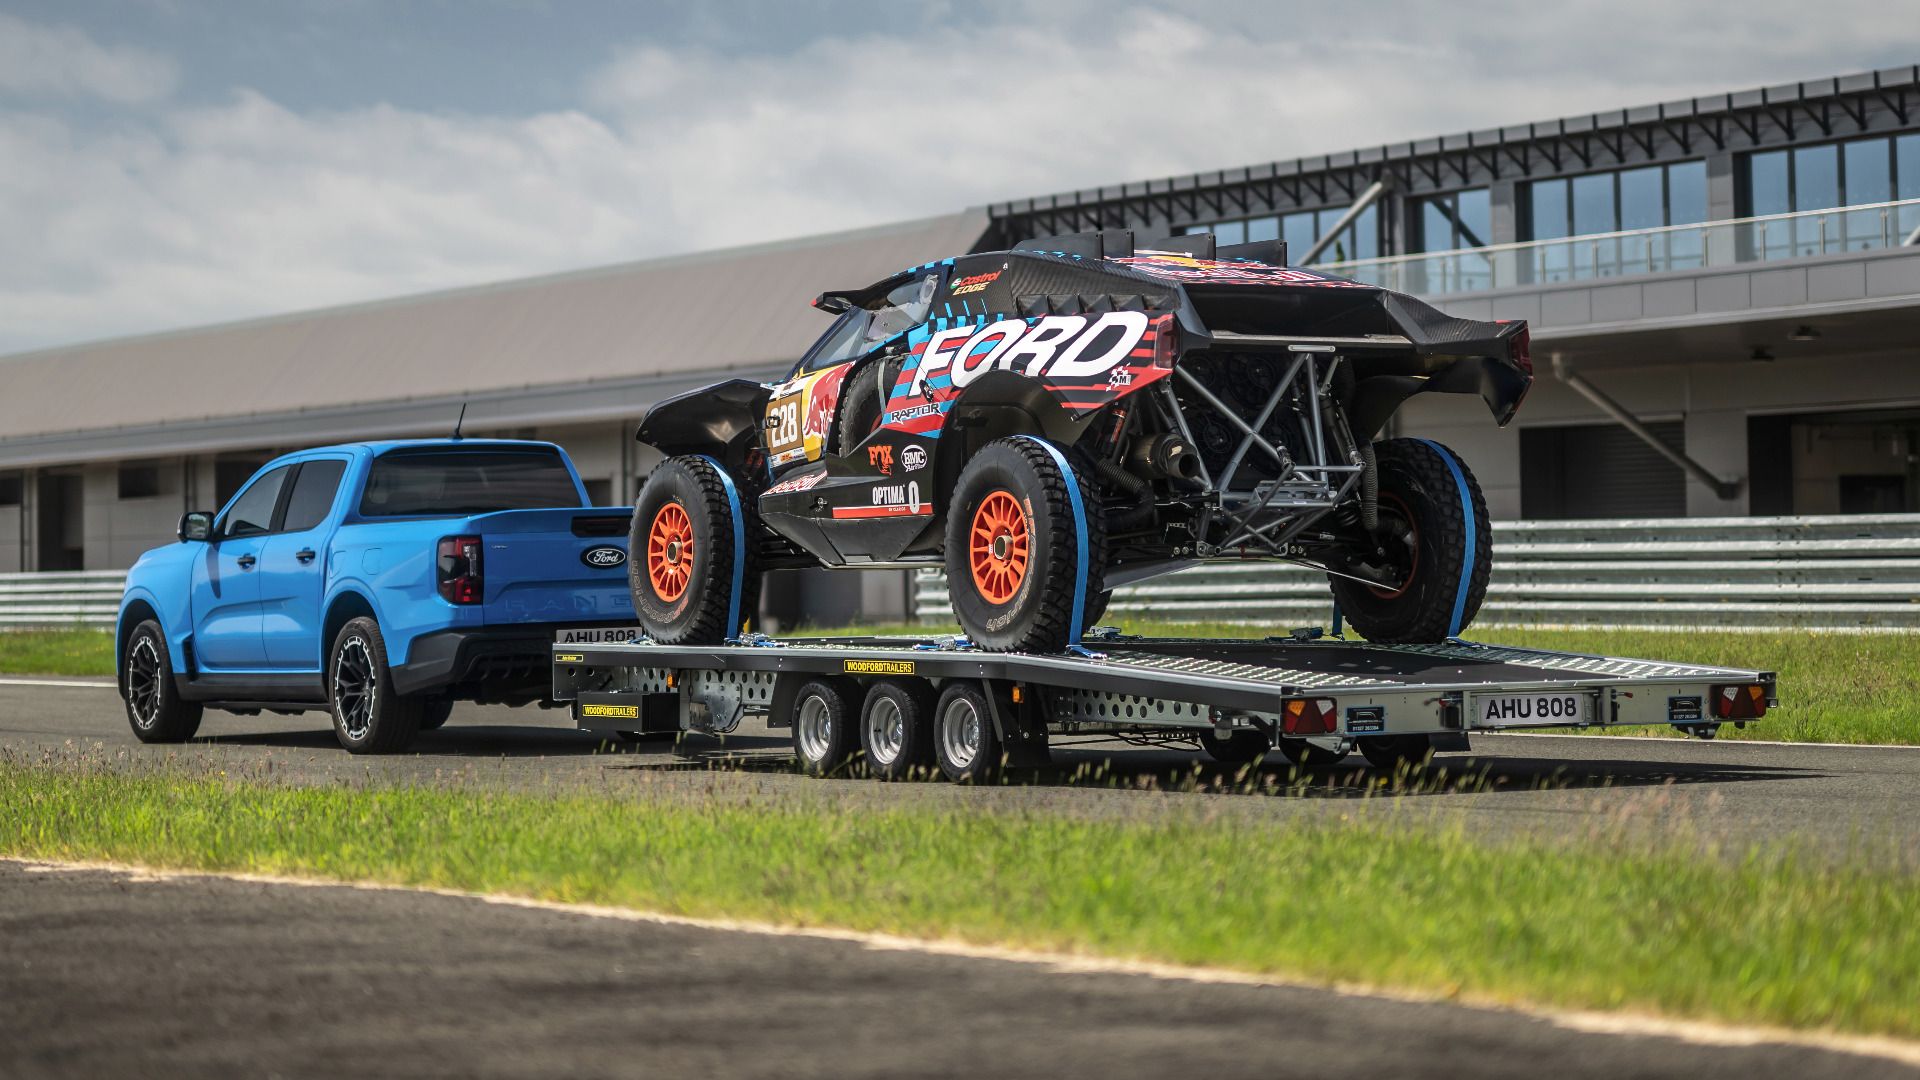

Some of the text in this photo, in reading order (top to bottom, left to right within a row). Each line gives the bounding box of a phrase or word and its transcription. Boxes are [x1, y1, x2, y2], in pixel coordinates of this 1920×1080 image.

[960, 271, 1002, 286] Castrol
[952, 281, 990, 295] EDGE
[909, 311, 1149, 399] FORD
[891, 402, 944, 425] RAPTOR
[769, 402, 798, 448] 228
[868, 445, 893, 466] FOX
[904, 452, 925, 464] BMC
[872, 486, 905, 505] OPTIMA
[593, 550, 619, 563] Ford
[564, 629, 637, 643] AHU 808
[846, 661, 912, 673] WOODFORDTRAILERS
[584, 706, 637, 717] WOODFORDTRAILERS
[1486, 697, 1577, 719] AHU 808
